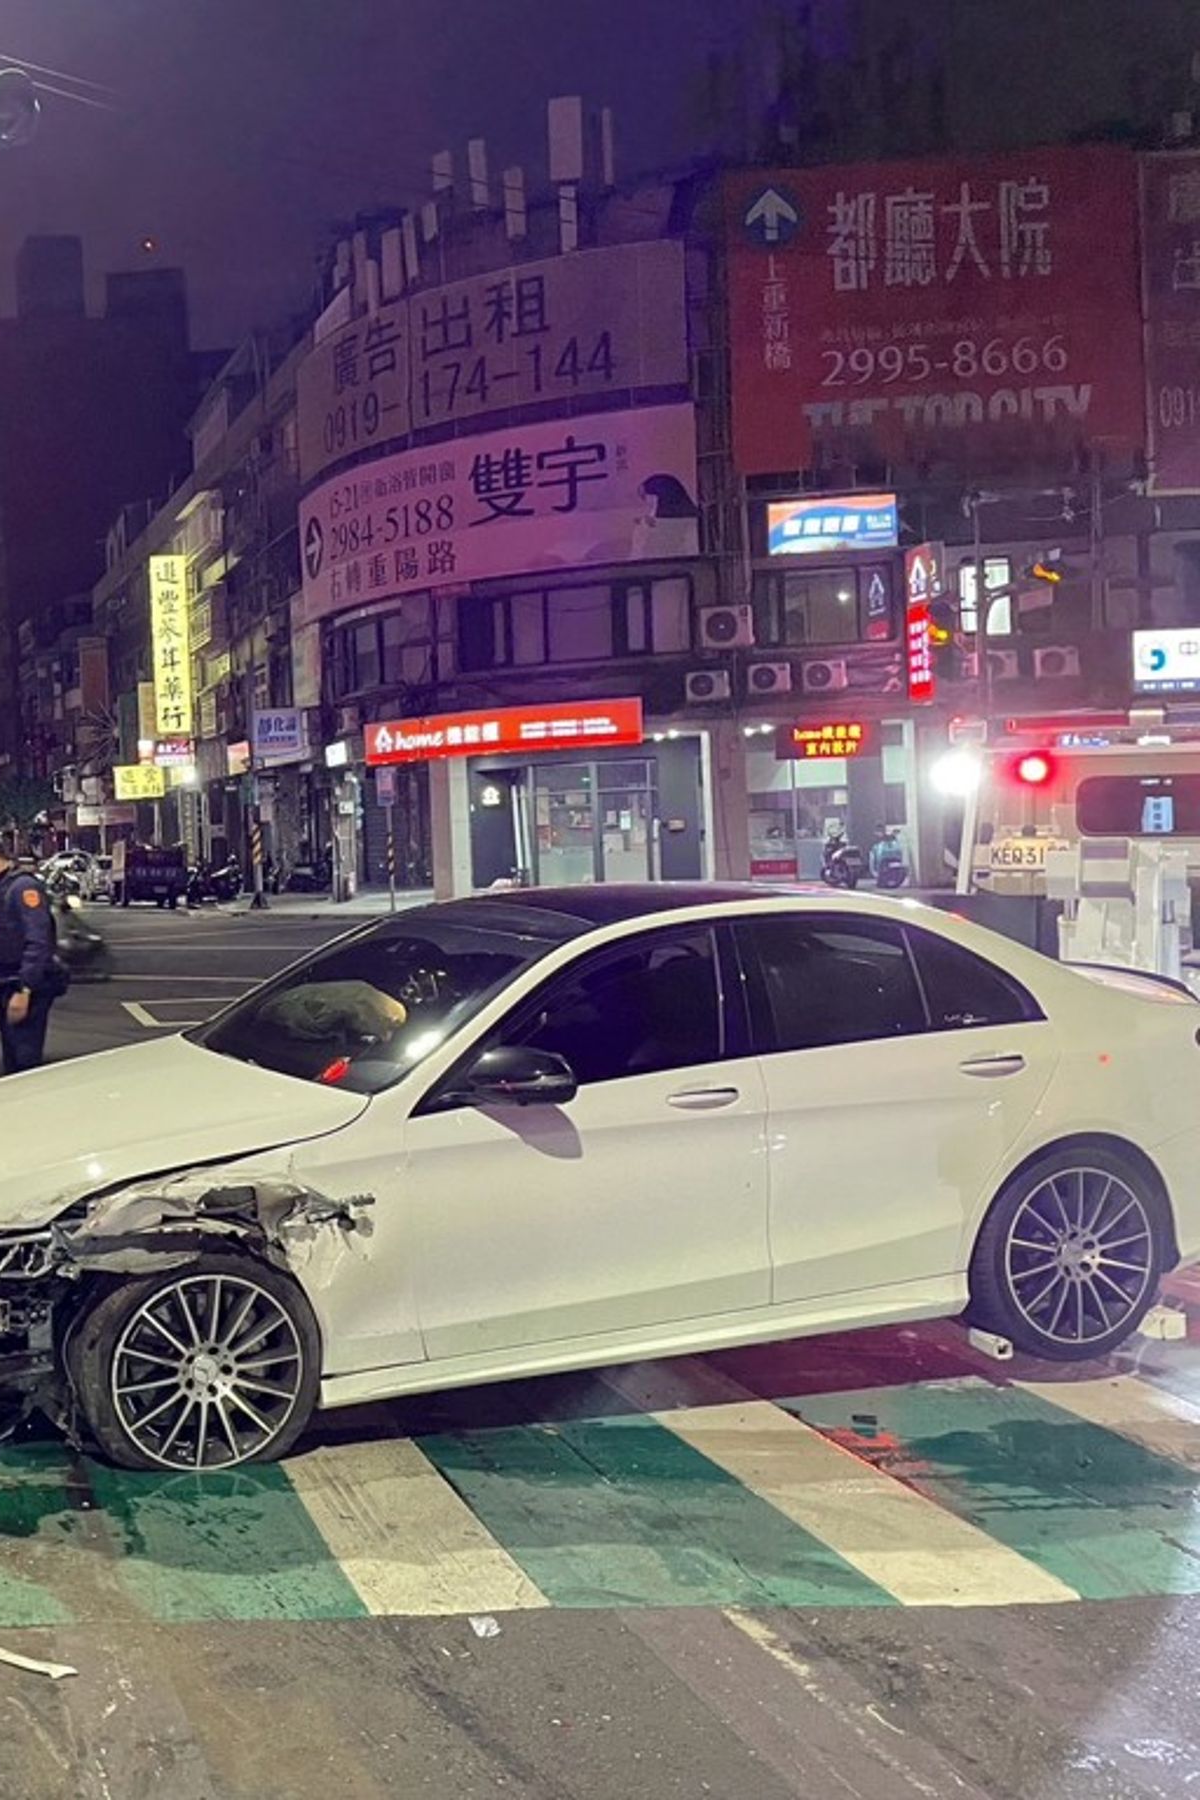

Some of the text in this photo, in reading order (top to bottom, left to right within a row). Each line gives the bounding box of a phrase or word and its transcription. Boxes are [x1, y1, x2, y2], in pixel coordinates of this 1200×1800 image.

[826, 176, 1052, 291] 都廳大院
[332, 275, 550, 394] 廣告出租
[820, 335, 1069, 387] 2995-8666
[322, 331, 616, 453] 0919-174-144
[330, 494, 454, 560] 2984-5188
[468, 435, 609, 529] 雙宇
